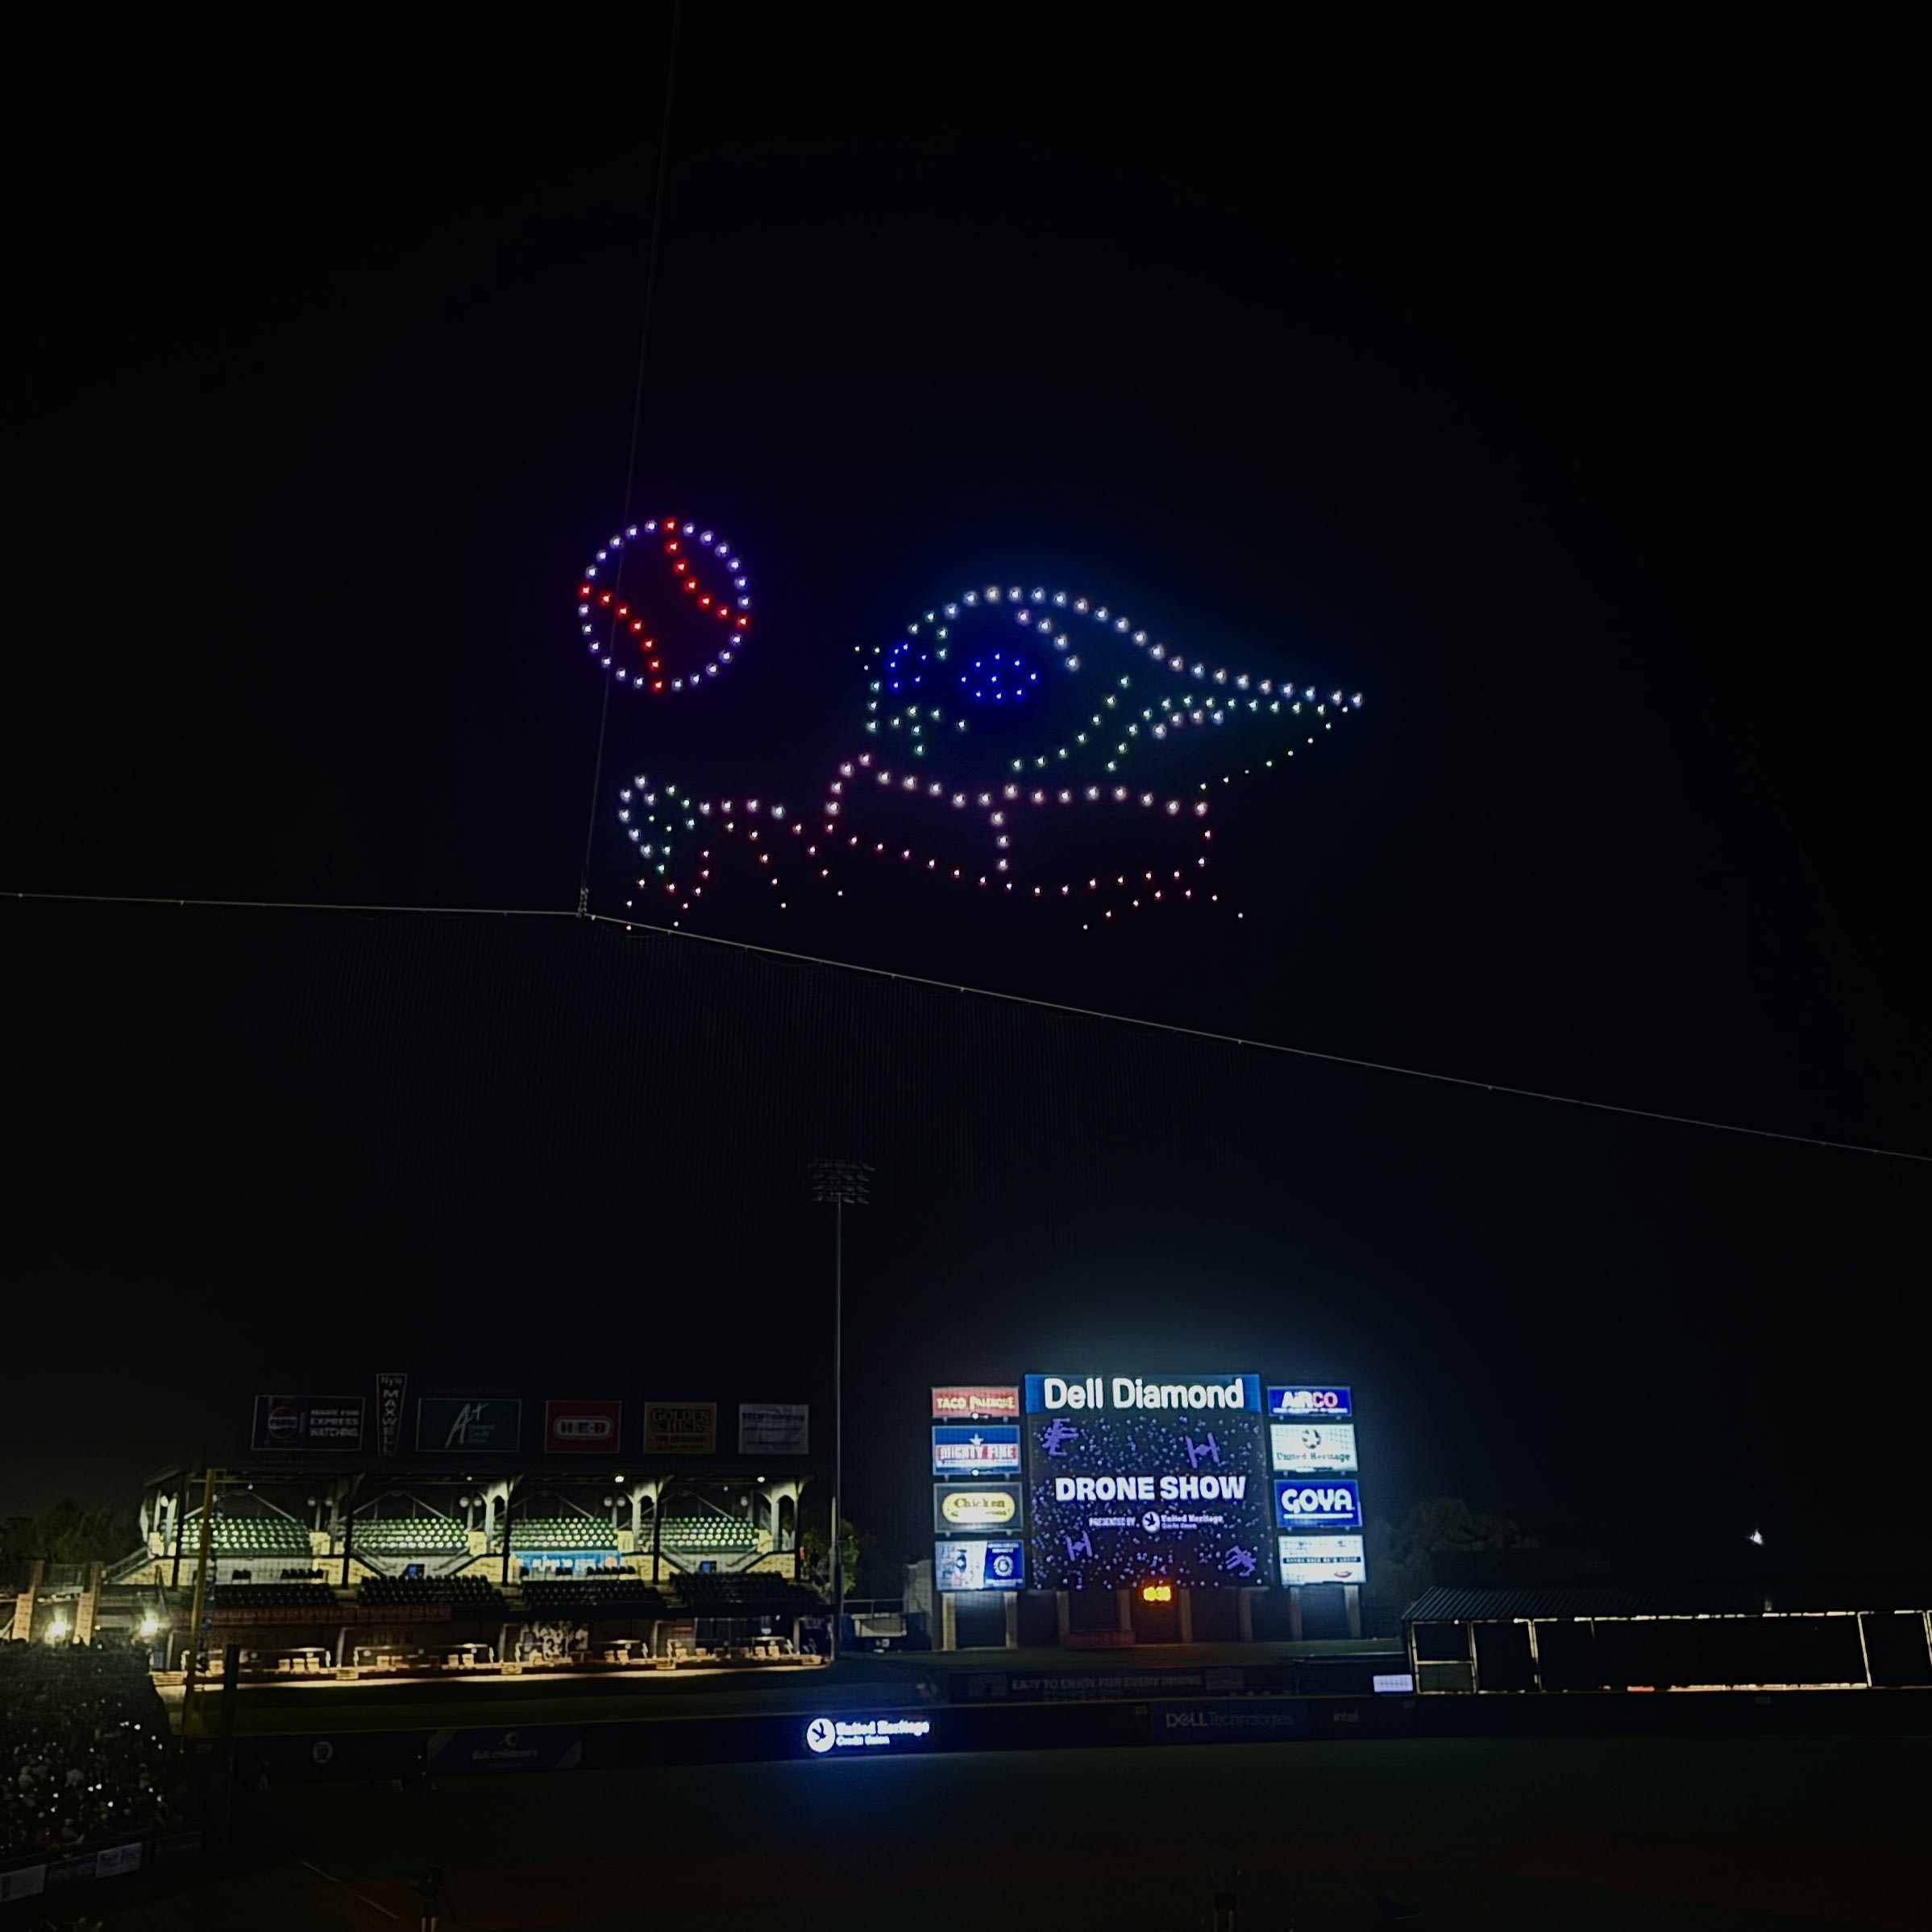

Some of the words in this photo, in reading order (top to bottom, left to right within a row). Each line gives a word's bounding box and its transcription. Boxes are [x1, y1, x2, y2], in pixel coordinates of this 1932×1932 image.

[937, 1397, 966, 1410] TACO
[1044, 1377, 1103, 1409] Dell
[1112, 1377, 1244, 1409] Diamond
[1055, 1477, 1155, 1501] DRONE
[1159, 1476, 1246, 1500] SHOW
[954, 1498, 1006, 1508] Chicken
[1281, 1488, 1352, 1514] GOYA
[1166, 1711, 1207, 1728] DELL
